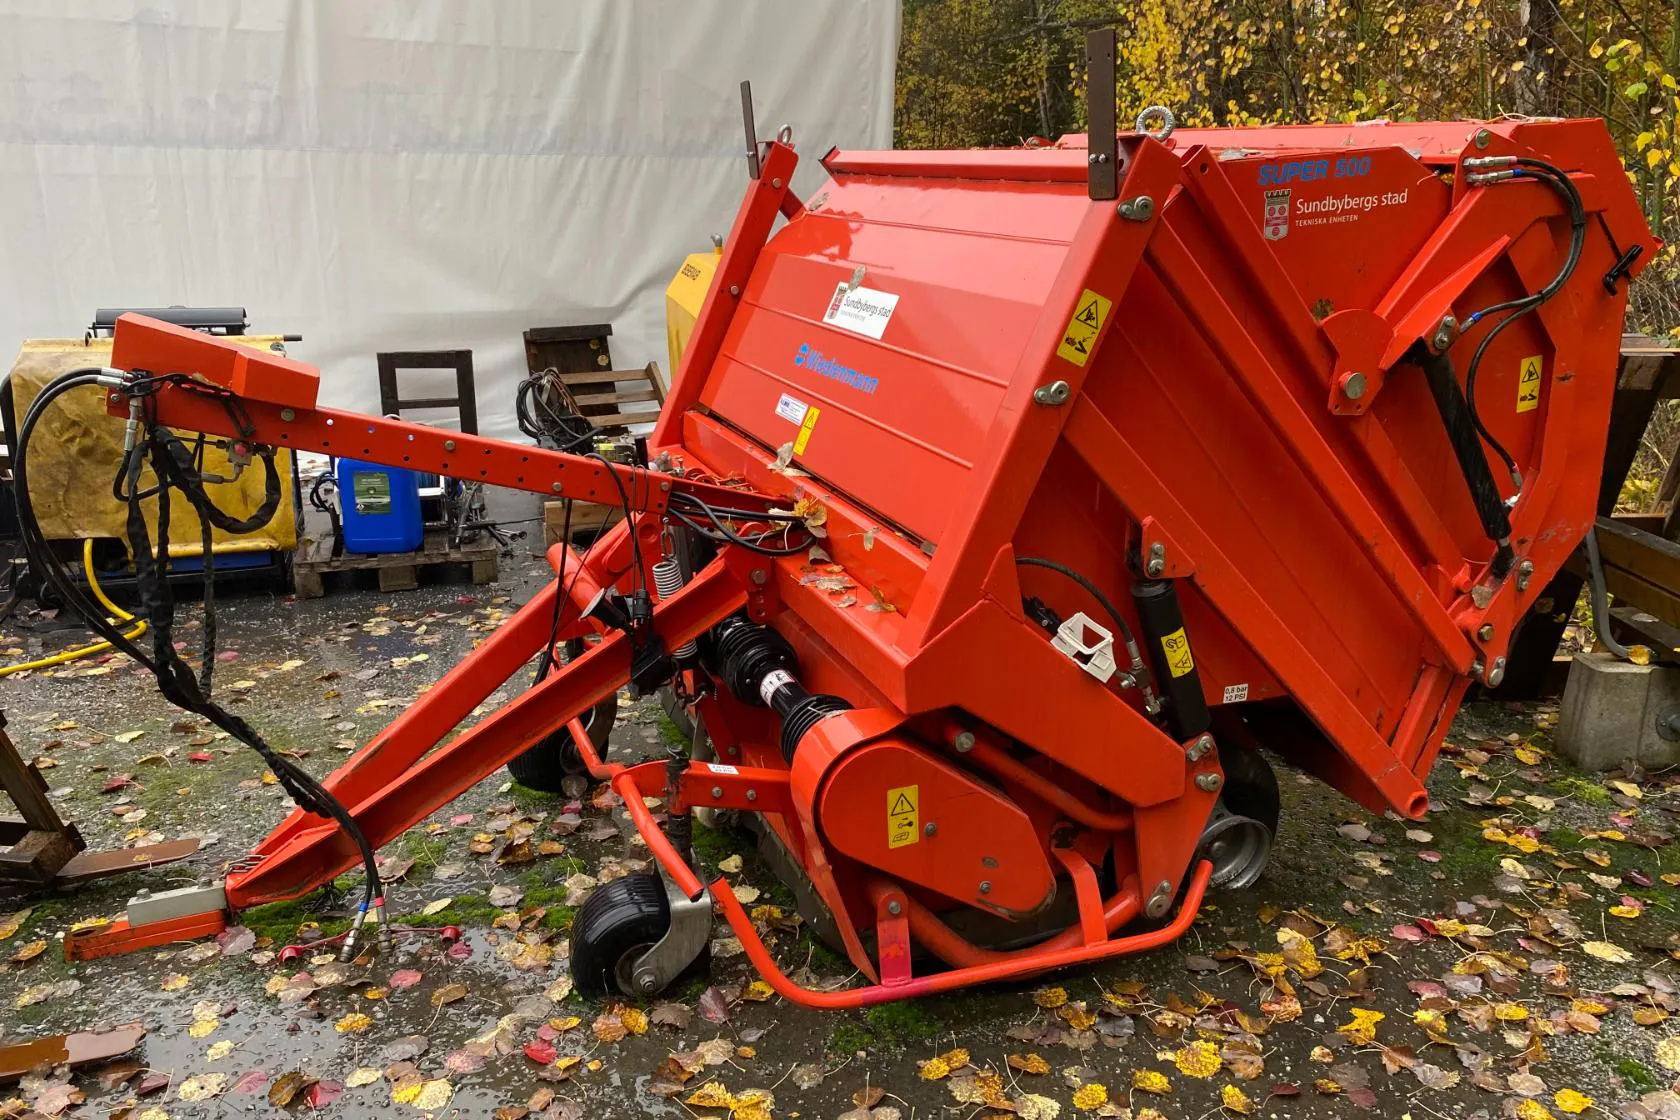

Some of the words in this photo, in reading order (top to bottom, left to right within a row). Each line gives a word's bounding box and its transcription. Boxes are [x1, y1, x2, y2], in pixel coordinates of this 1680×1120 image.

[1257, 159, 1329, 186] SUPER
[1334, 155, 1372, 178] 500
[1296, 195, 1378, 215] Sundbybergs
[1381, 188, 1408, 204] stad
[1295, 217, 1327, 227] TEKNISKA
[1329, 214, 1359, 224] ENHETEN
[843, 296, 879, 317] Sundbybergs
[877, 305, 893, 318] stad
[805, 349, 878, 395] Wiedenmann
